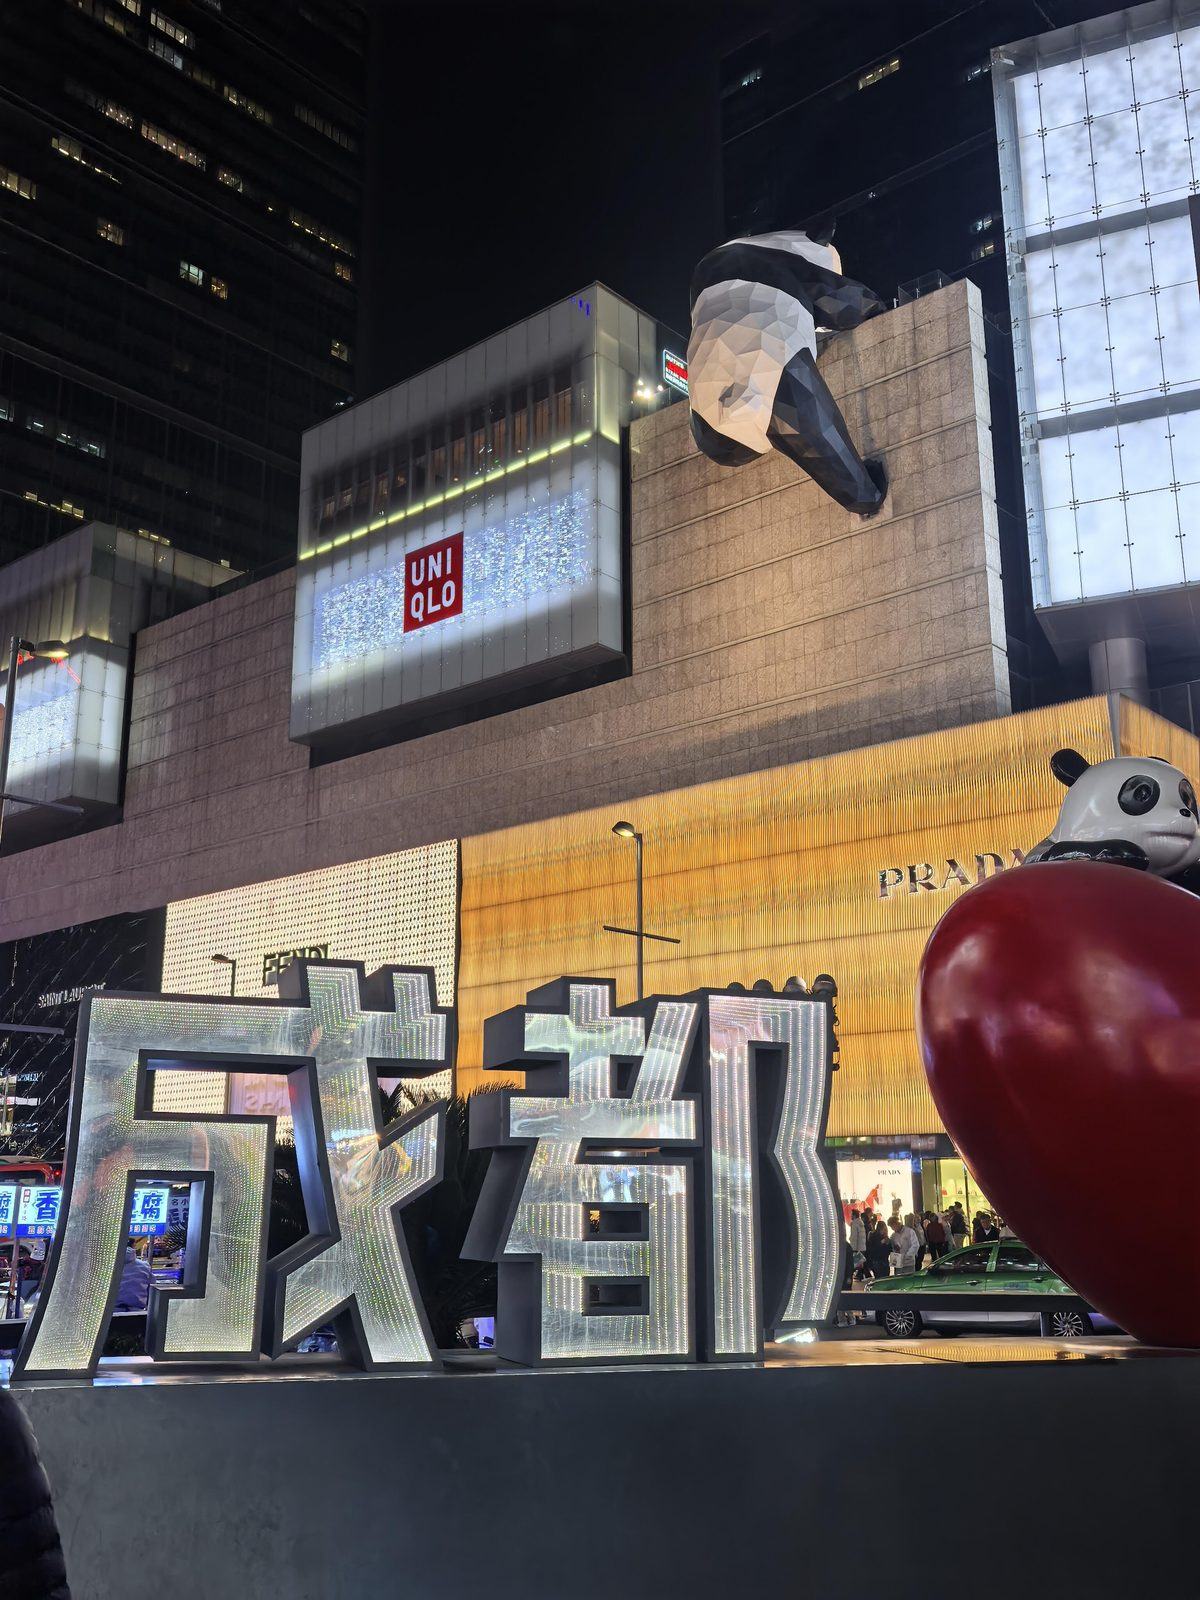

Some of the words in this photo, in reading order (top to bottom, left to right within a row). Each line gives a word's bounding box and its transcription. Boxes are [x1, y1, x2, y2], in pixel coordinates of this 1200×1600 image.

[411, 547, 452, 587] UNI
[410, 580, 456, 622] QLO
[14, 960, 846, 1380] 成都
[35, 1191, 59, 1220] 香
